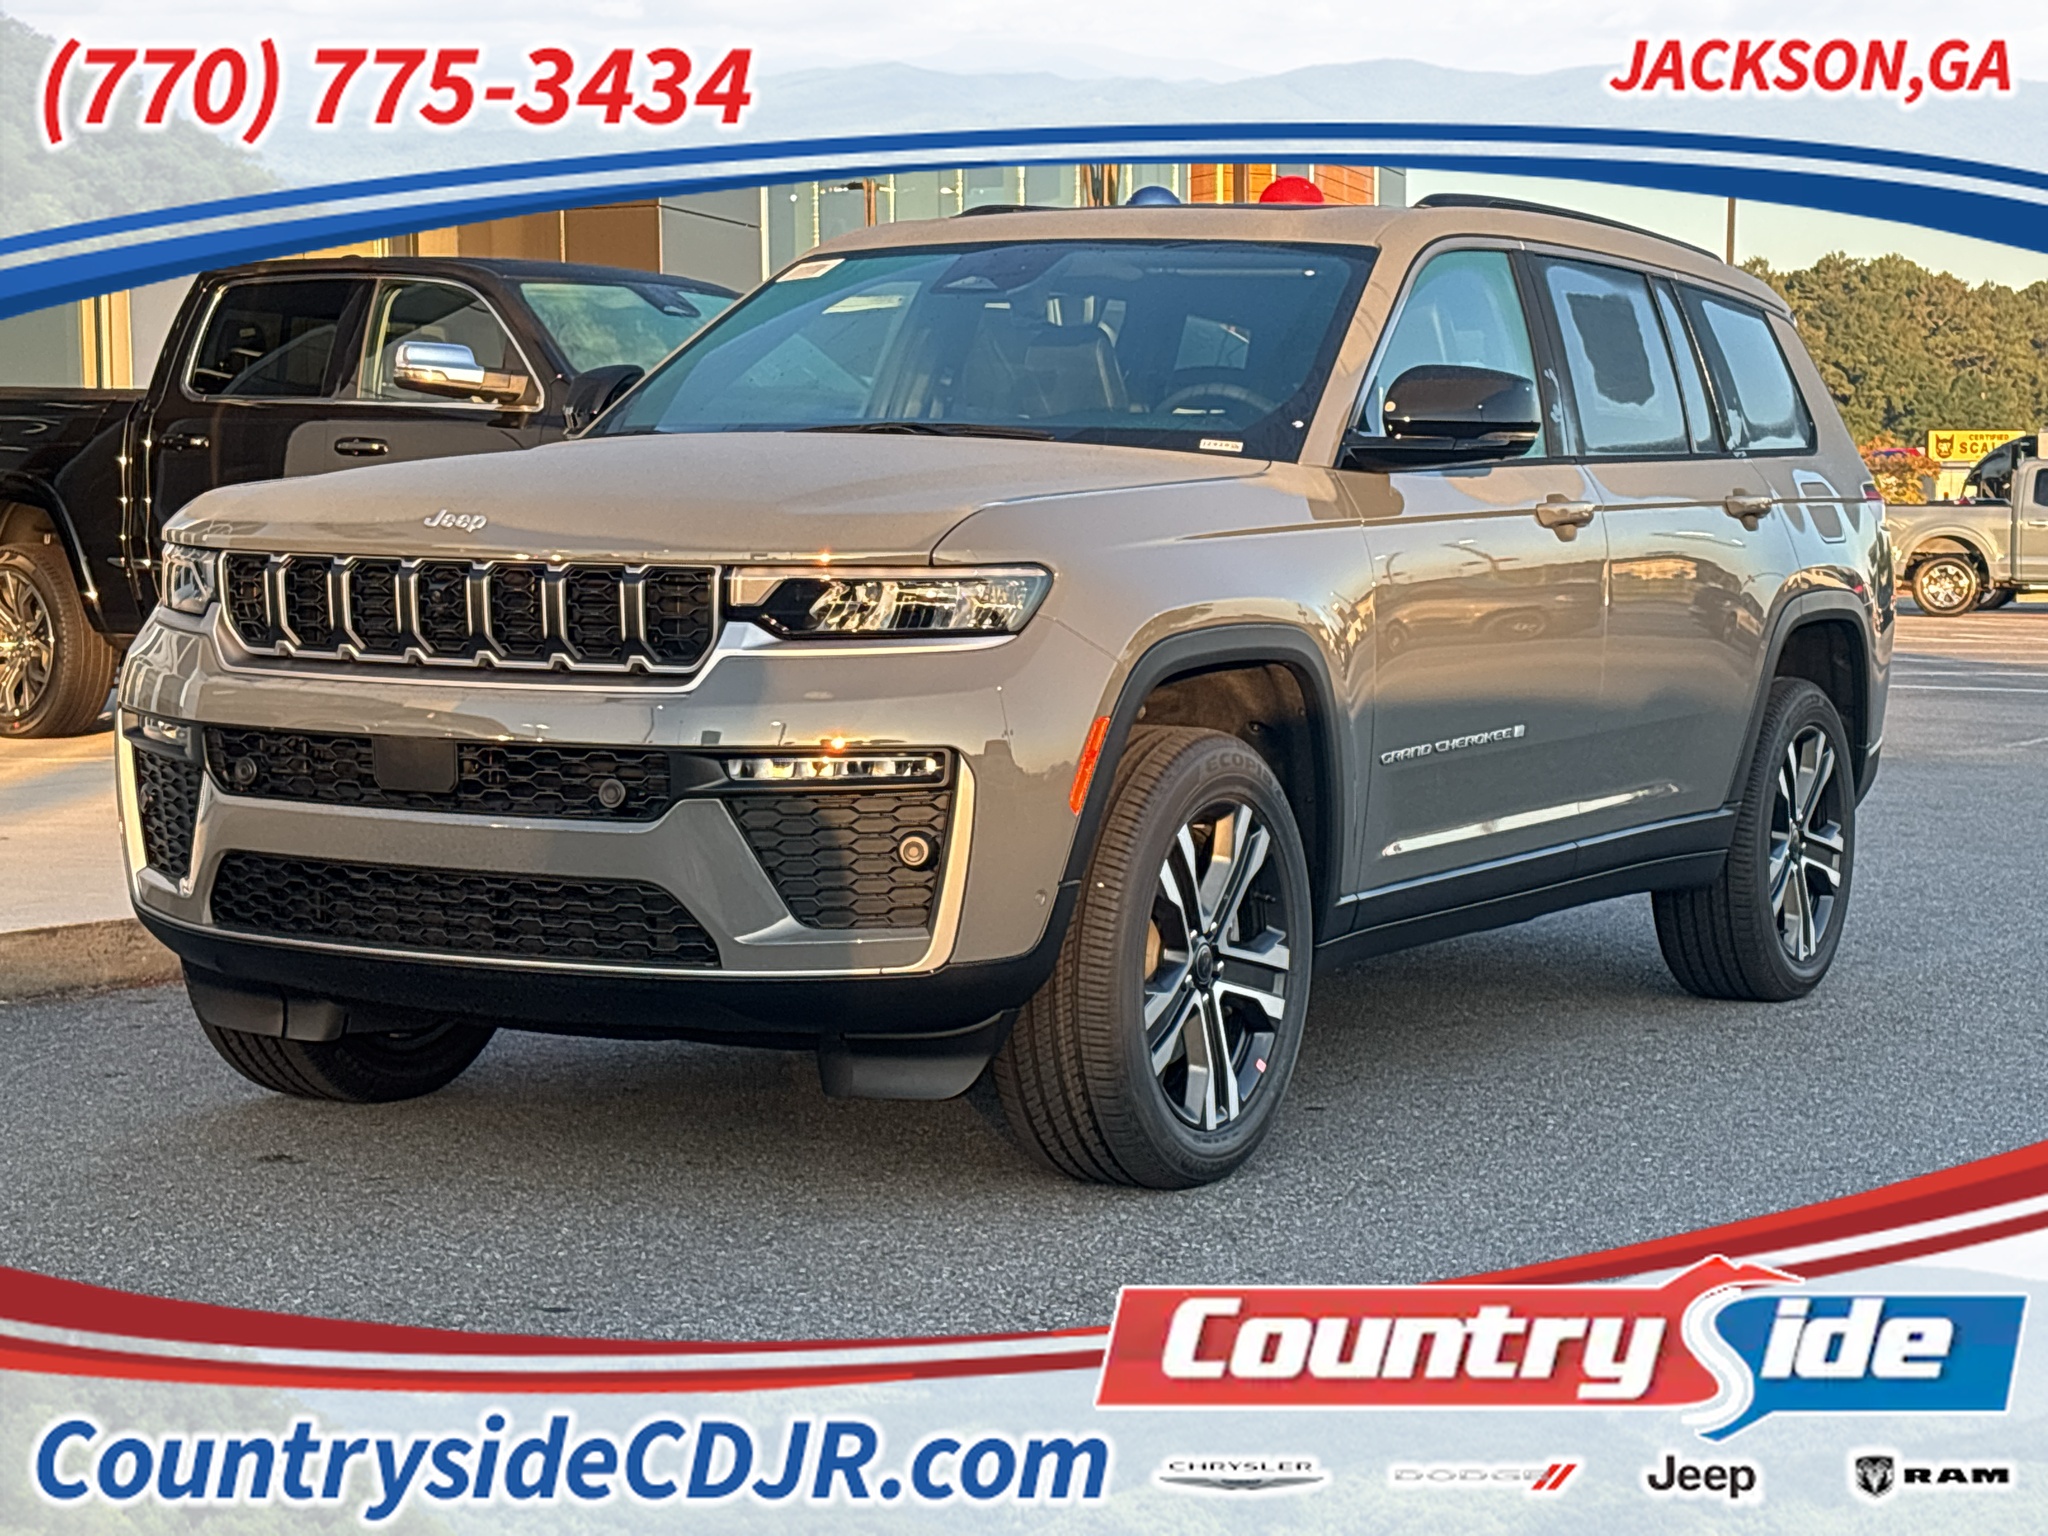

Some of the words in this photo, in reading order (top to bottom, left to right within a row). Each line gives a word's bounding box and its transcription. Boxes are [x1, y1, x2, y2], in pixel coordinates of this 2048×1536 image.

[1968, 433, 2010, 441] CERTIFIED
[423, 509, 487, 533] Jeep
[1380, 744, 1432, 764] GRAND
[1435, 727, 1512, 752] CHEROKEE
